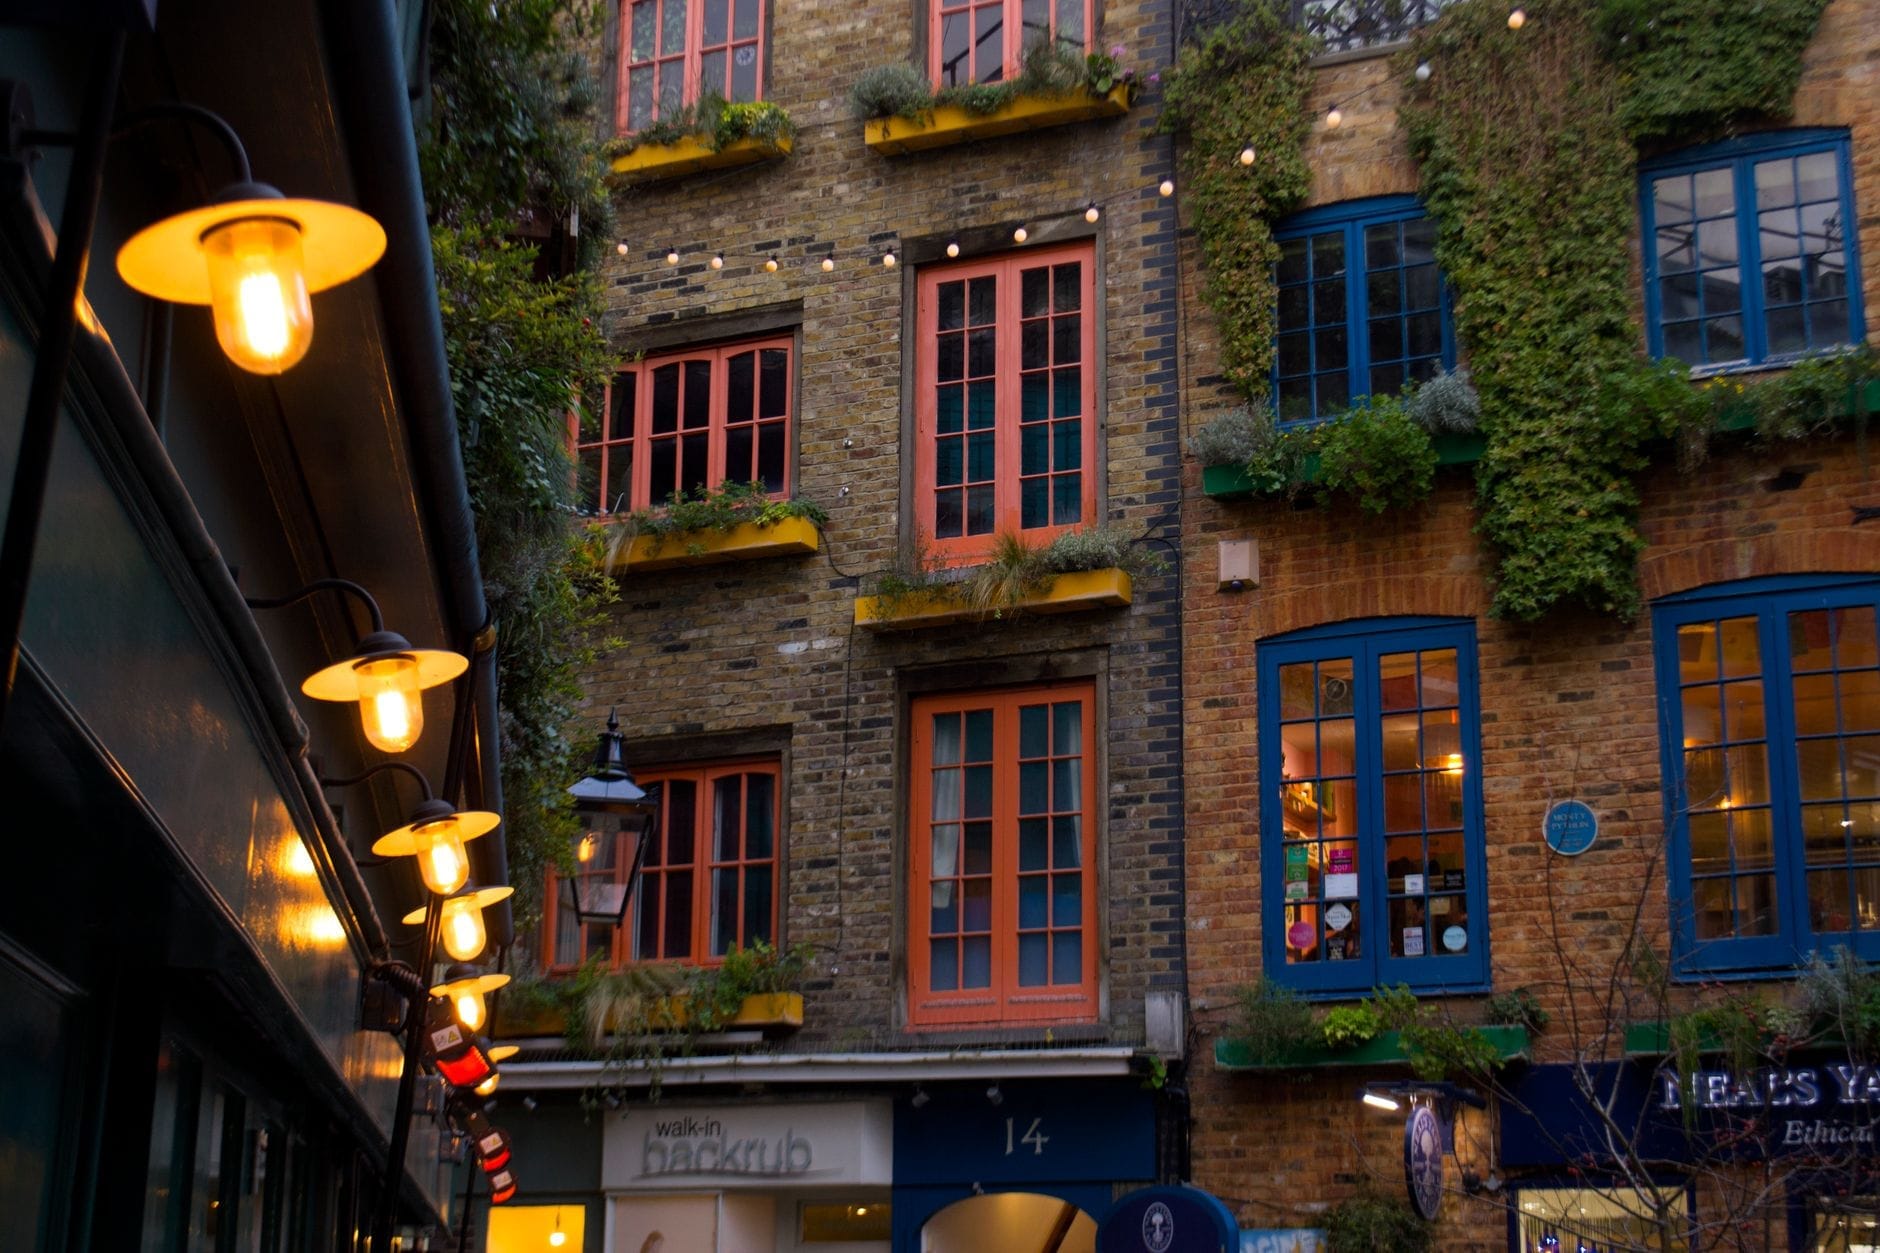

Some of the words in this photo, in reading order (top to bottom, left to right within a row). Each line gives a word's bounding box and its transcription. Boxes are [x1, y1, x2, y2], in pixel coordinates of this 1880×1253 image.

[656, 1116, 721, 1137] walk-in
[1005, 1117, 1050, 1156] 14
[642, 1128, 813, 1173] backrub
